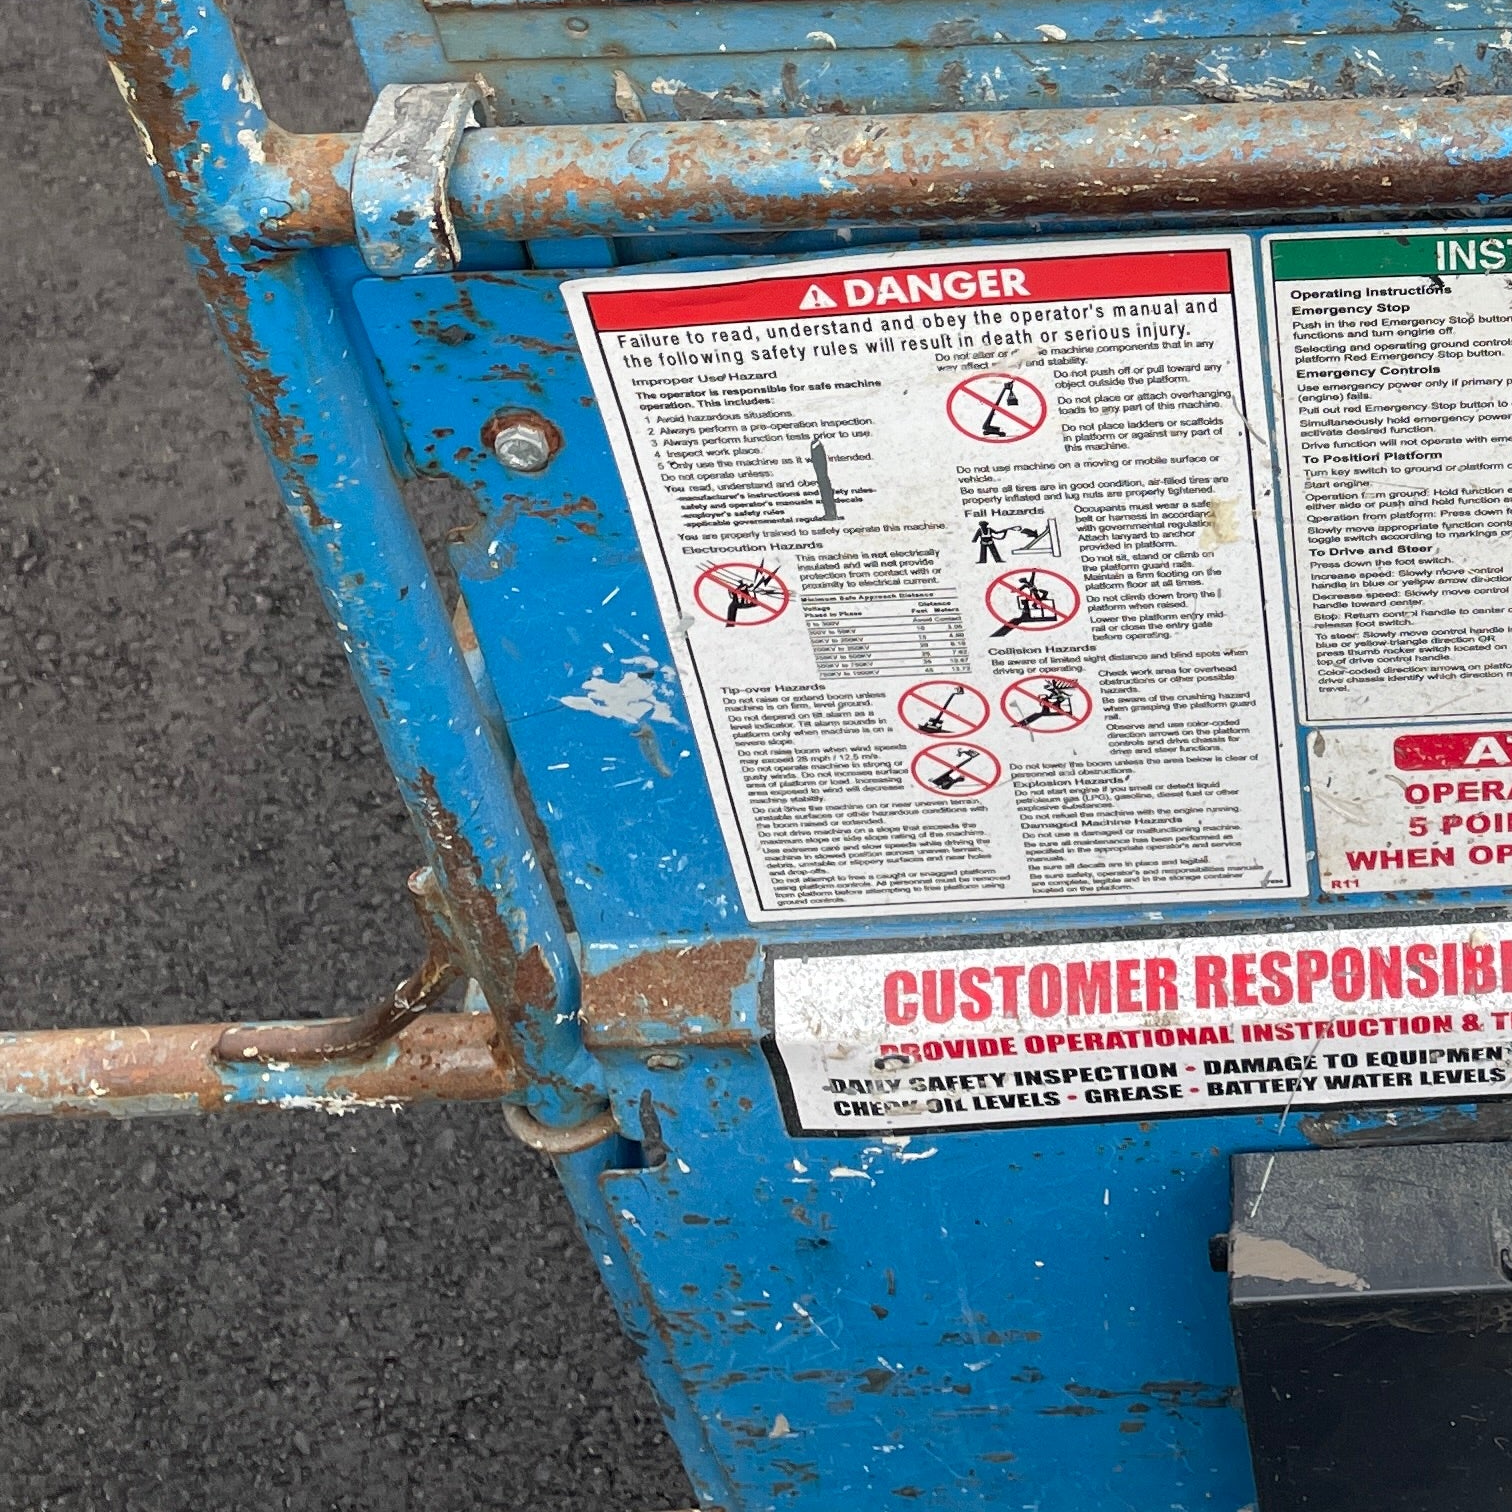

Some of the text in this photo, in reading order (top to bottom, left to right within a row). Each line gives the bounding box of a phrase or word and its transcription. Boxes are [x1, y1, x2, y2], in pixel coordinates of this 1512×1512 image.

[847, 267, 1032, 308] DANGER
[1290, 284, 1452, 301] Operating Instructions
[1292, 302, 1411, 317] Emergency Stop
[617, 297, 1219, 349] Failure to read, understand and obey the operator's manual and
[624, 320, 1192, 369] the following safety rules will result in death or serious injury.
[632, 374, 695, 388] Improper
[728, 369, 778, 381] Hazard
[1296, 364, 1441, 380] Emergency Controls
[1303, 450, 1443, 464] To Position Platform
[964, 506, 1045, 518] Fall Hazards
[682, 540, 824, 555] Electrocution Hazards
[988, 643, 1098, 656] Collision Hazards
[720, 682, 827, 696] Tip-over Hazards
[1408, 815, 1429, 837] 5
[1346, 846, 1455, 872] WHEN
[883, 956, 1178, 1026] CUSTOMER
[880, 1036, 1018, 1064] PROVIDE
[1024, 1025, 1235, 1055] OPERATIONAL
[1242, 1014, 1453, 1043] INSTRUCTION
[1461, 1013, 1482, 1033] &
[909, 1072, 1007, 1093] SAFETY
[1013, 1062, 1178, 1086] INSPECTION
[1204, 1055, 1318, 1075] DAMAGE
[1324, 1052, 1358, 1068] TO
[1367, 1045, 1503, 1067] EQUIPMEN
[926, 1097, 968, 1114] OIL
[974, 1091, 1061, 1110] LEVELS
[1085, 1084, 1184, 1105] GREASE
[1207, 1076, 1319, 1096] BATTERY
[1324, 1071, 1413, 1090] WATER
[1420, 1067, 1507, 1086] LEVELS
